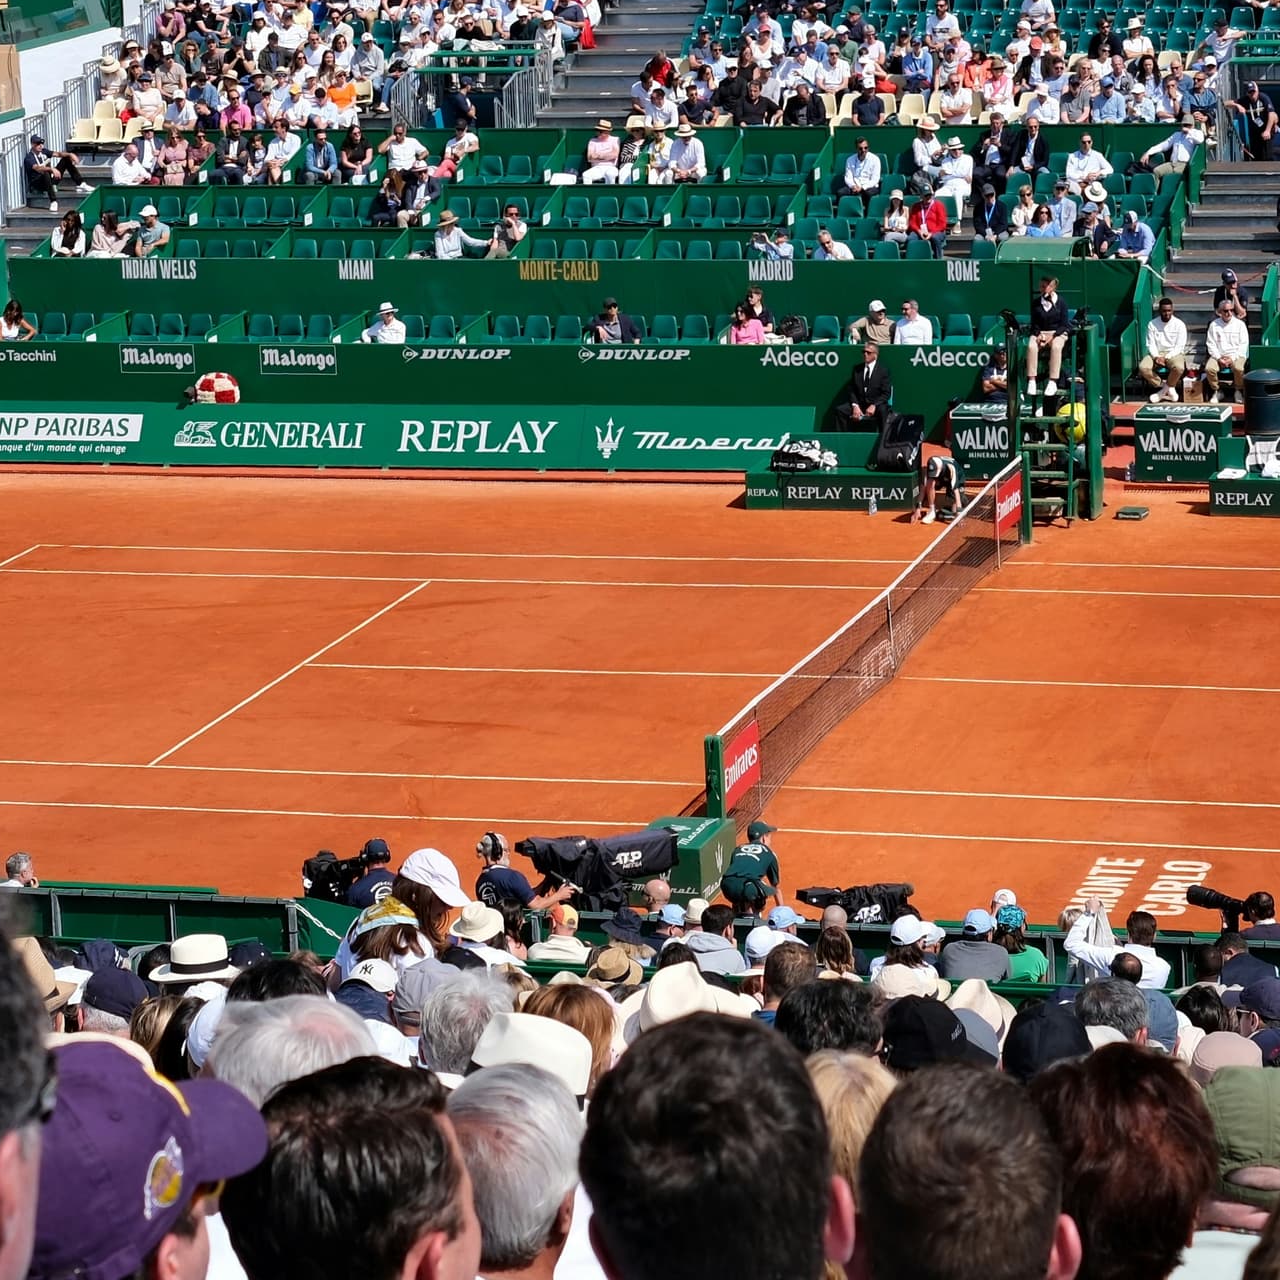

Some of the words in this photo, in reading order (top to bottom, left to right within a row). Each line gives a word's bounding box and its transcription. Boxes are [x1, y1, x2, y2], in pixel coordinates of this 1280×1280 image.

[121, 259, 157, 280] INDIAN
[158, 259, 197, 280] WELLS
[338, 259, 374, 280] MIAMI
[520, 260, 599, 281] MONTE-CARLO
[748, 260, 794, 281] MADRID
[947, 260, 980, 282] ROME
[6, 349, 57, 362] Tacchini
[122, 348, 193, 370] Malongo
[262, 348, 335, 370] Malongo
[420, 348, 512, 360] DUNLOP
[596, 349, 691, 361] DUNLOP
[760, 346, 839, 367] Adecco
[910, 346, 991, 367] Adecco
[34, 417, 130, 437] PARIBAS
[220, 421, 366, 449] GENERALI
[396, 420, 559, 453] REPLAY
[24, 442, 44, 452] d'un
[46, 443, 76, 453] monde
[78, 443, 93, 455] qui
[95, 443, 127, 455] change
[632, 431, 792, 452] Maserat
[1138, 428, 1217, 453] VALMORA
[1152, 454, 1183, 462] MINERAL
[1183, 454, 1207, 462] WATER
[747, 488, 779, 498] REPLAY
[787, 486, 843, 500] REPLAY
[851, 487, 908, 501] REPLAY
[996, 486, 1022, 518] Emirates
[1215, 492, 1273, 506] REPLAY
[724, 742, 758, 793] Emirates
[611, 850, 643, 866] ATP
